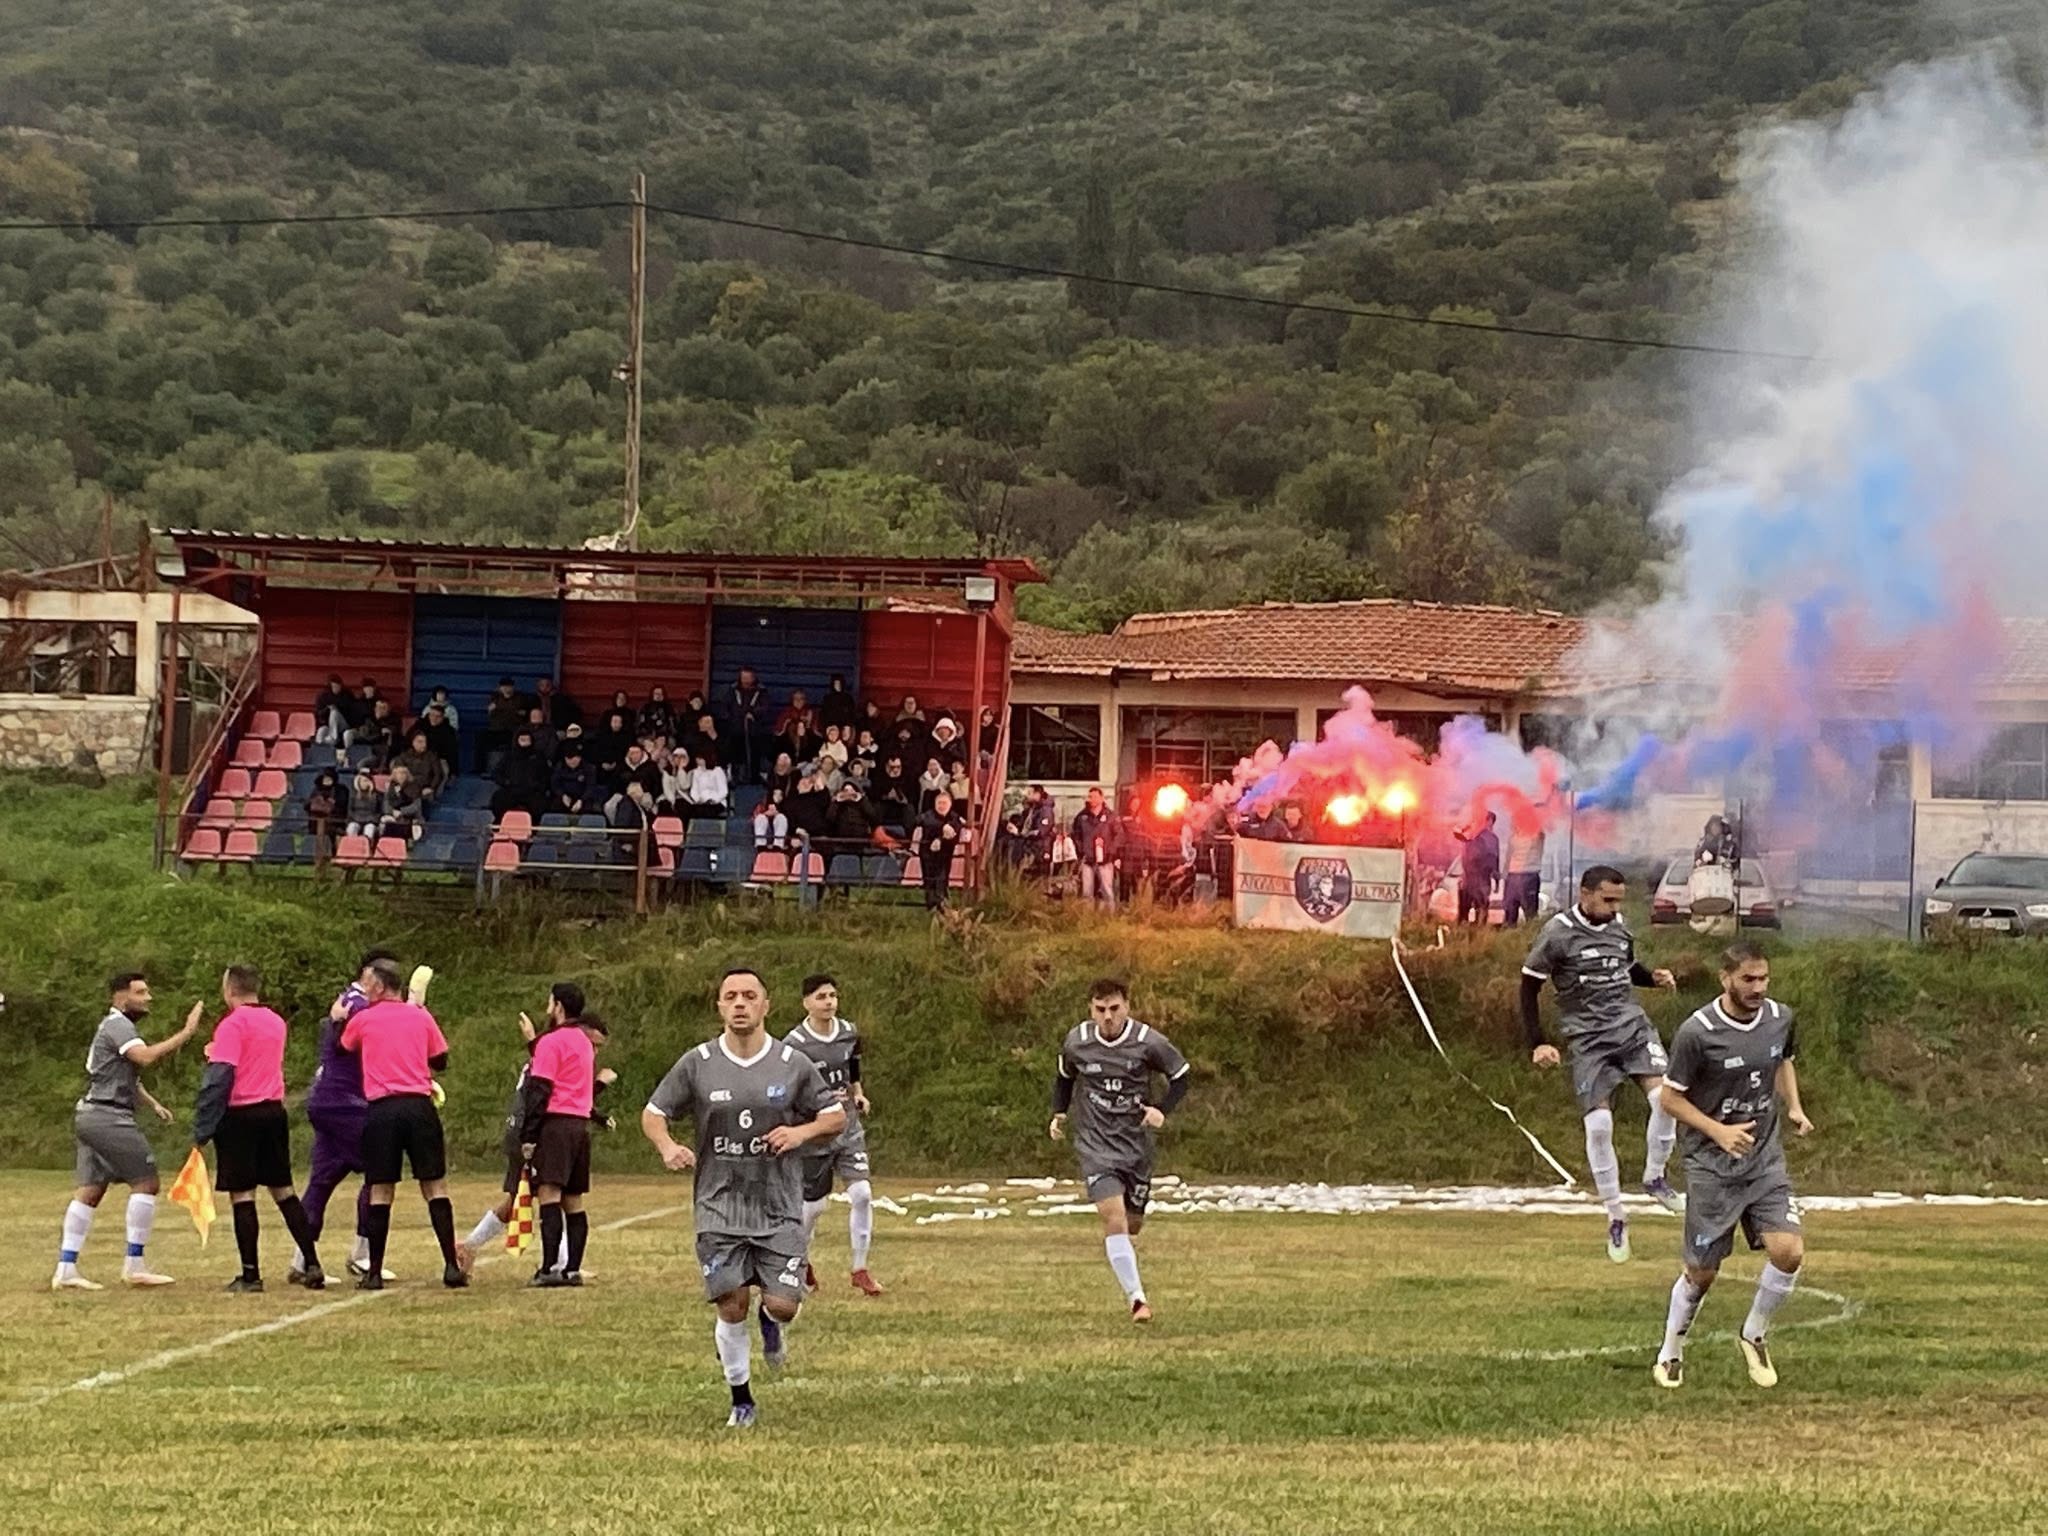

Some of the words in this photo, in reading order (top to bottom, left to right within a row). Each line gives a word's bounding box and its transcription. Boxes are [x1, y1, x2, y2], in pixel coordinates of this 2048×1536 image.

[828, 1069, 843, 1084] 11
[1749, 1070, 1761, 1089] 5
[738, 1108, 753, 1129] 6
